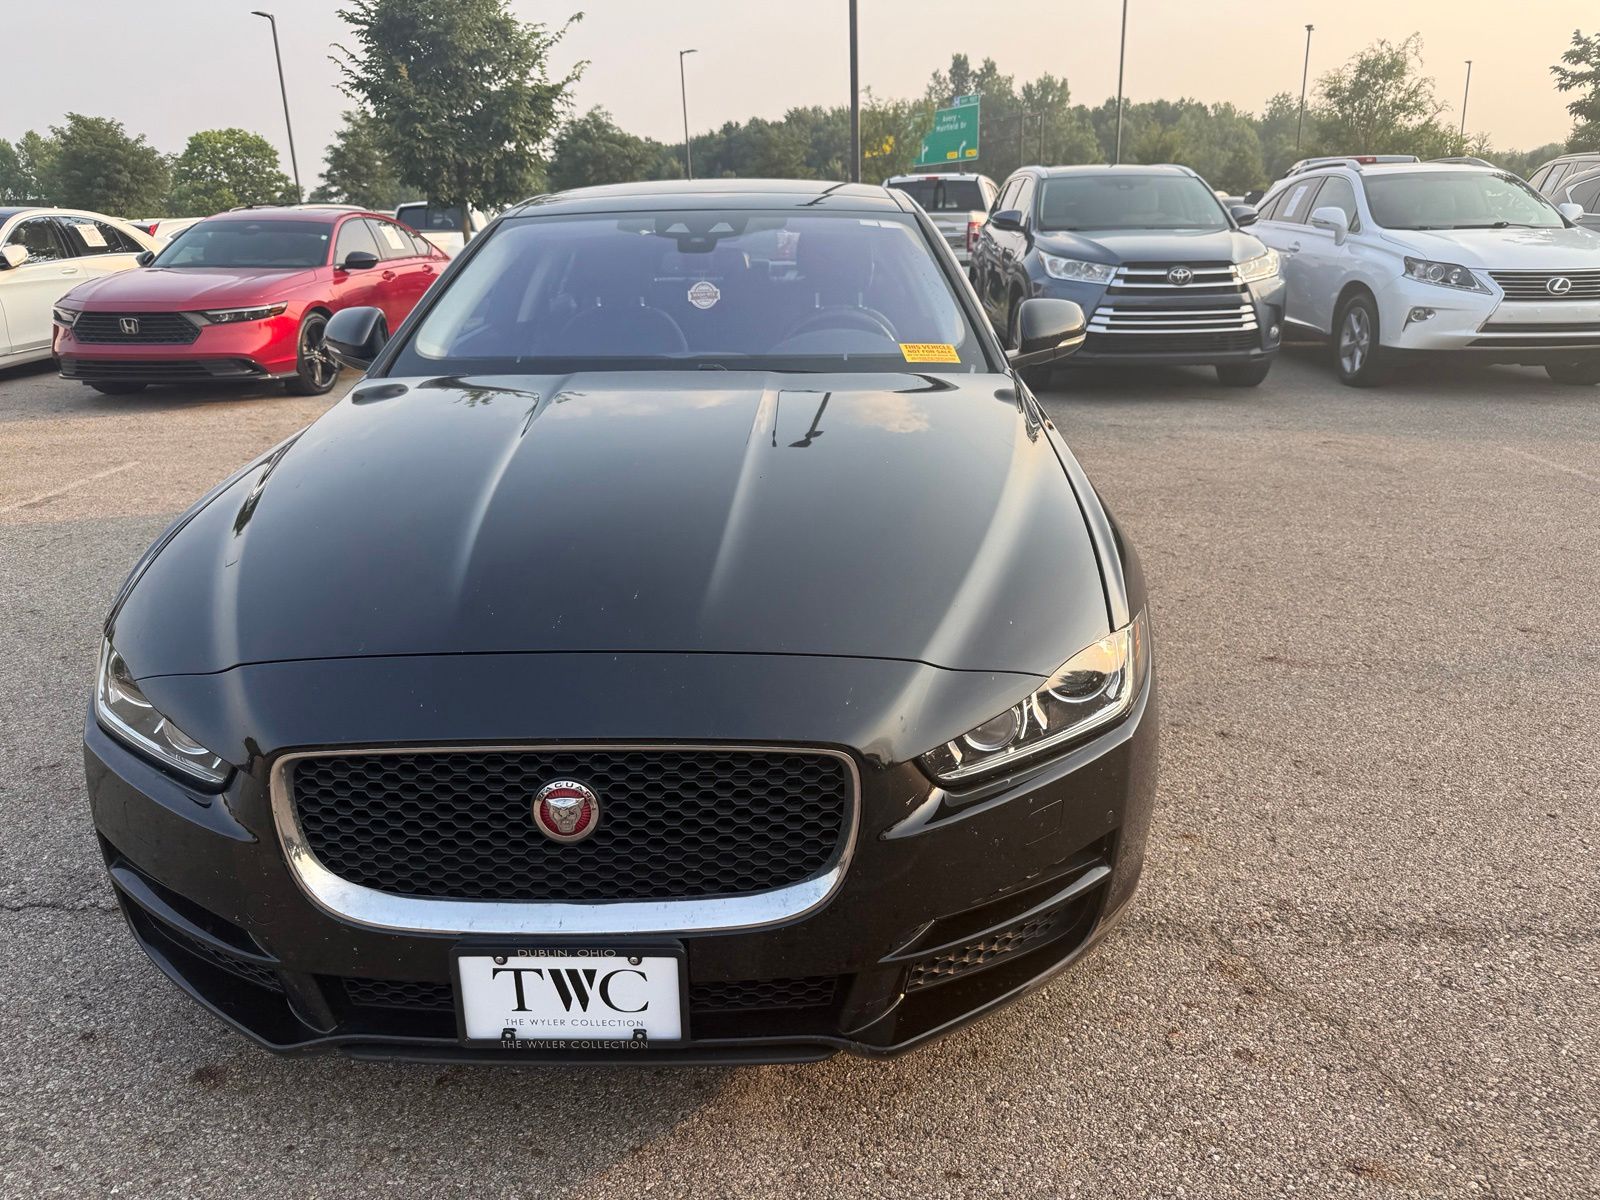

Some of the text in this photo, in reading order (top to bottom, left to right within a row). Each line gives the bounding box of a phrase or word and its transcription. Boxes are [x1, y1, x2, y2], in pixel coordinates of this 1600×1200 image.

[577, 949, 617, 957] OHIO
[492, 968, 649, 1013] TWC
[505, 1018, 644, 1027] THE WYLER COLLECTION
[500, 1040, 649, 1049] THE WYLER COLLECTION
